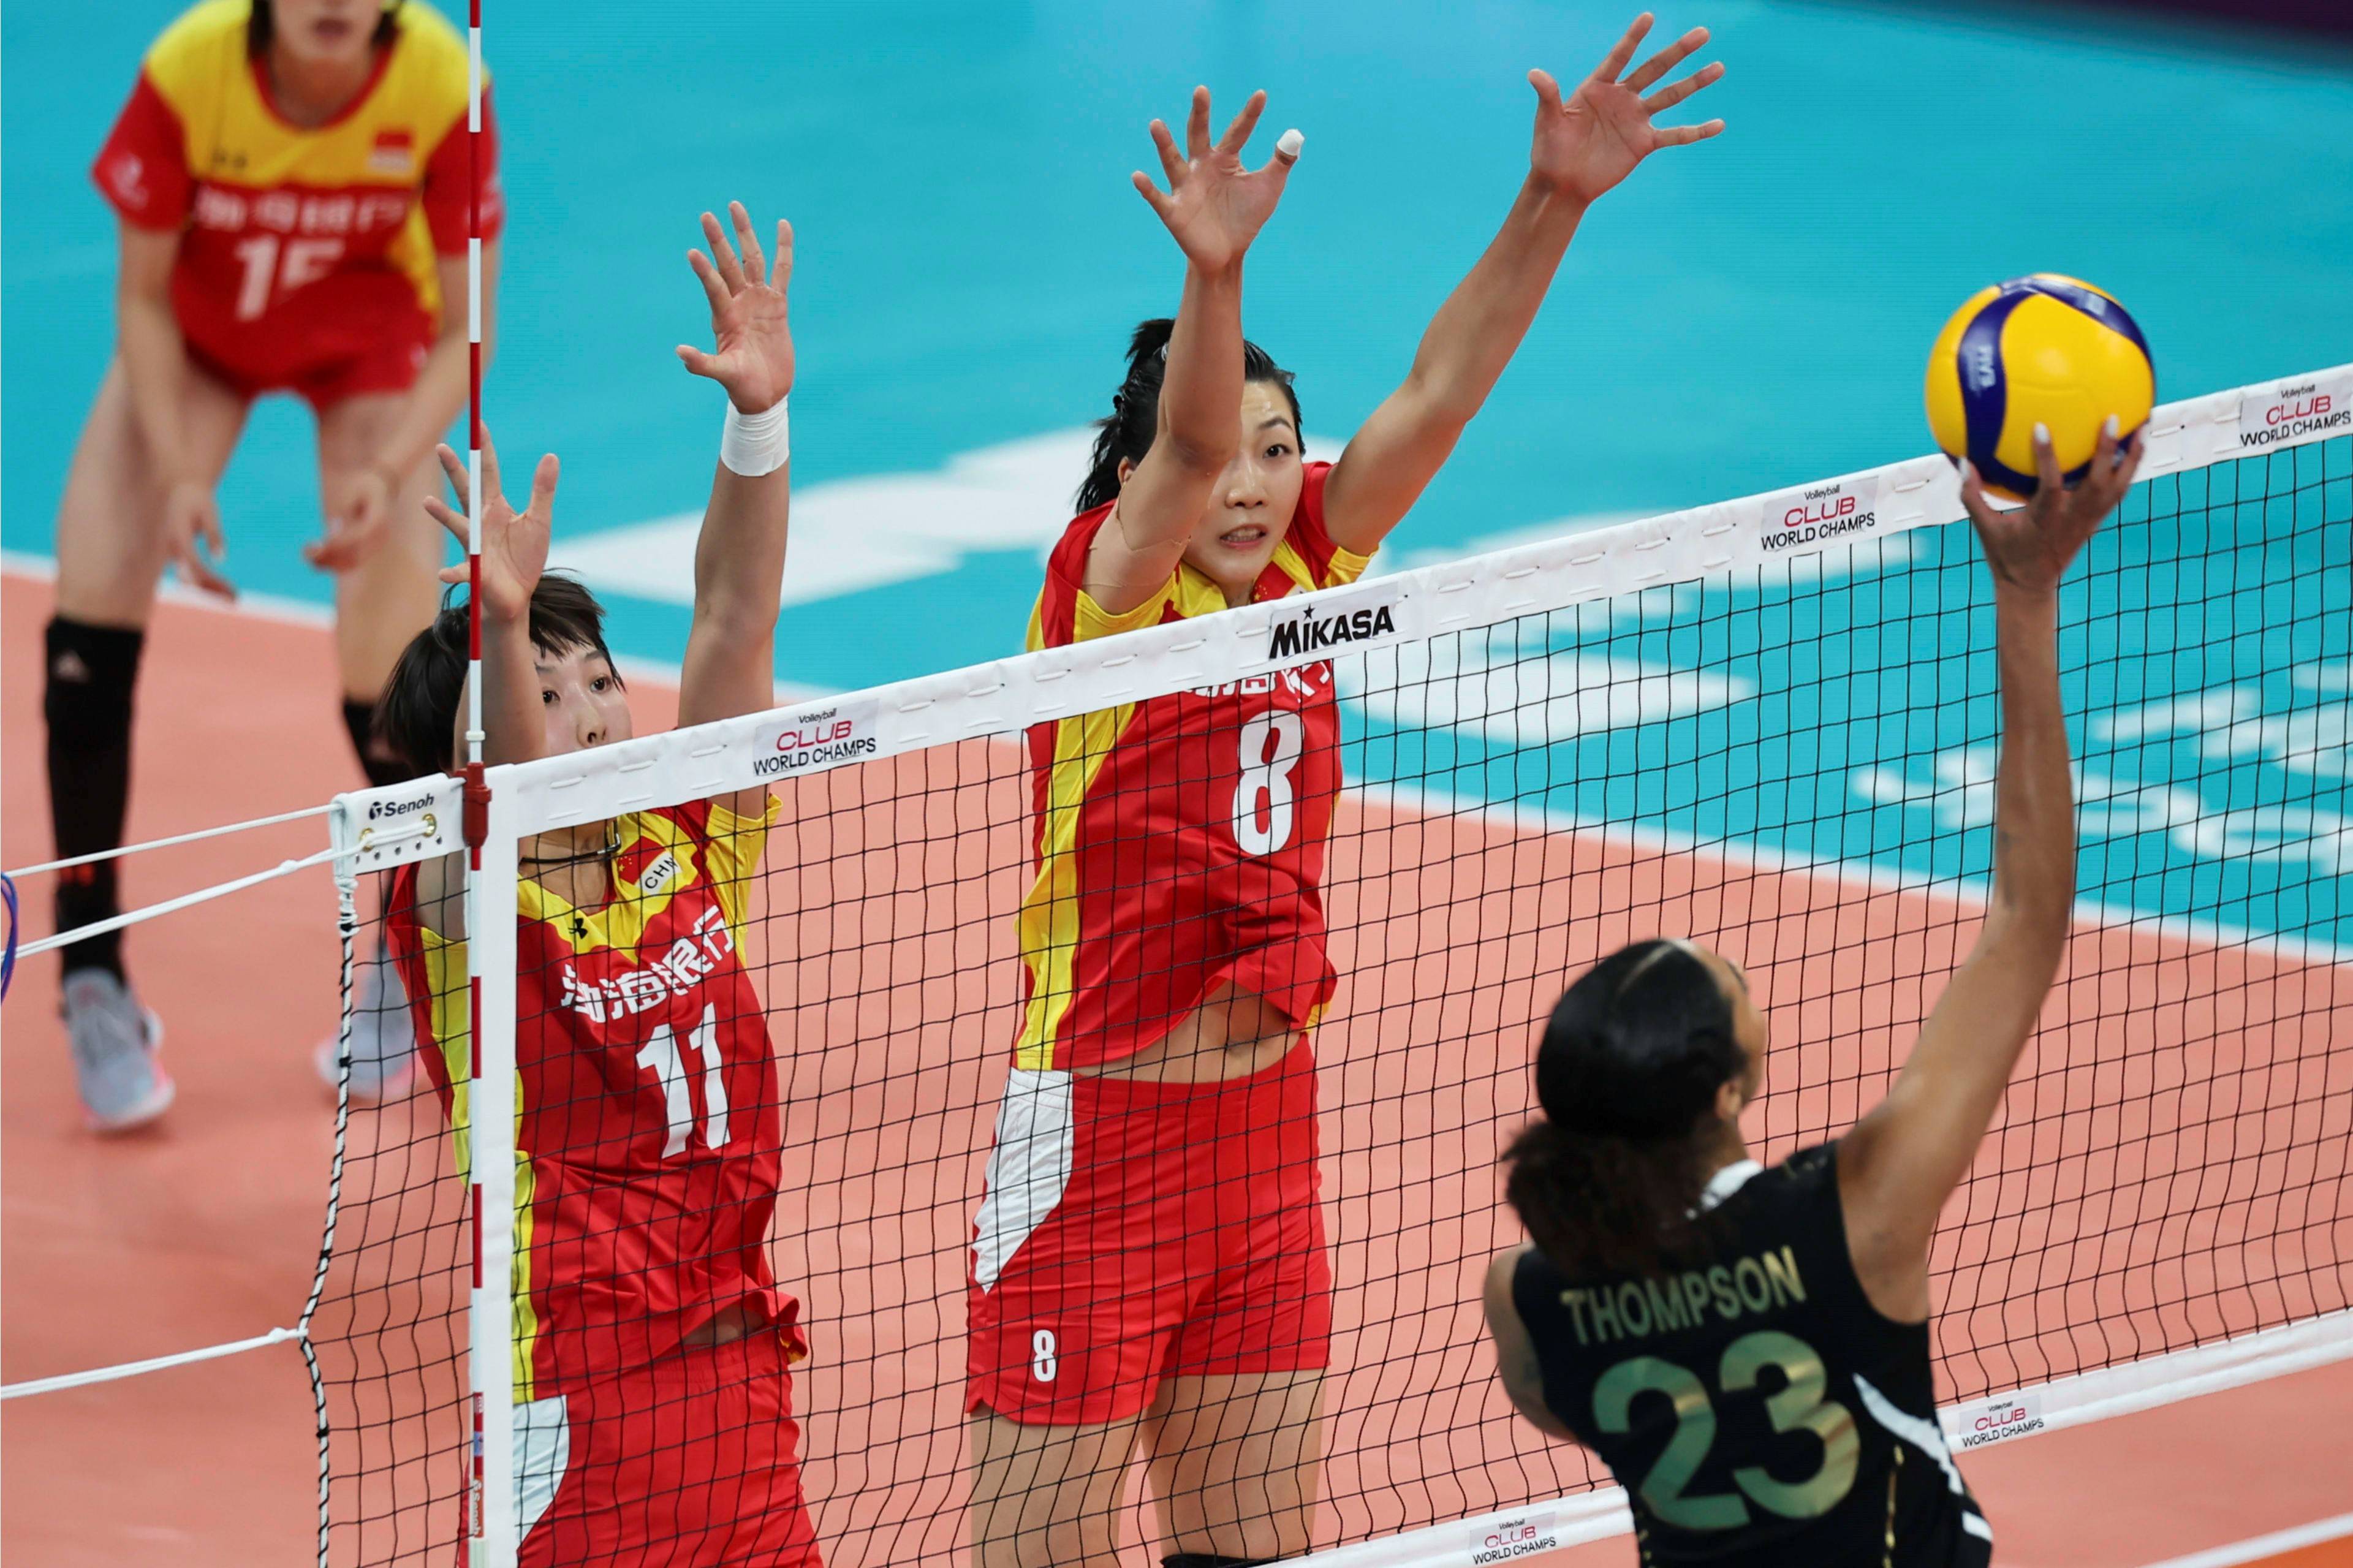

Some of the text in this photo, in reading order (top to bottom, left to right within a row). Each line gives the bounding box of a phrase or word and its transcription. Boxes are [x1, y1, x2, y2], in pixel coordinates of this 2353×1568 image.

[2266, 395, 2332, 425] CLUB
[2240, 411, 2351, 447] WORLD CHAMPS
[1804, 484, 1840, 500] Volleyball
[1784, 496, 1855, 528] CLUB
[1761, 512, 1875, 551] WORLD CHAMPS
[1269, 604, 1395, 659] MIKASA
[798, 708, 837, 724] Volleyball
[776, 720, 853, 751] CLUB
[754, 737, 876, 776] WORLD CHAMPS
[1232, 710, 1305, 855] 8
[384, 793, 434, 817] Senoh
[645, 857, 679, 889] CHN
[636, 1002, 731, 1159] 11
[1559, 1245, 1807, 1344] THOMPSON
[1033, 1330, 1056, 1382] 8
[1593, 1330, 1861, 1529] 23
[1962, 1418, 2044, 1447] WORLD CHAMPS
[1975, 1407, 2026, 1431] CLUB
[1472, 1537, 1556, 1565] WORLD CHAMPS
[1485, 1526, 1536, 1549] CLUB
